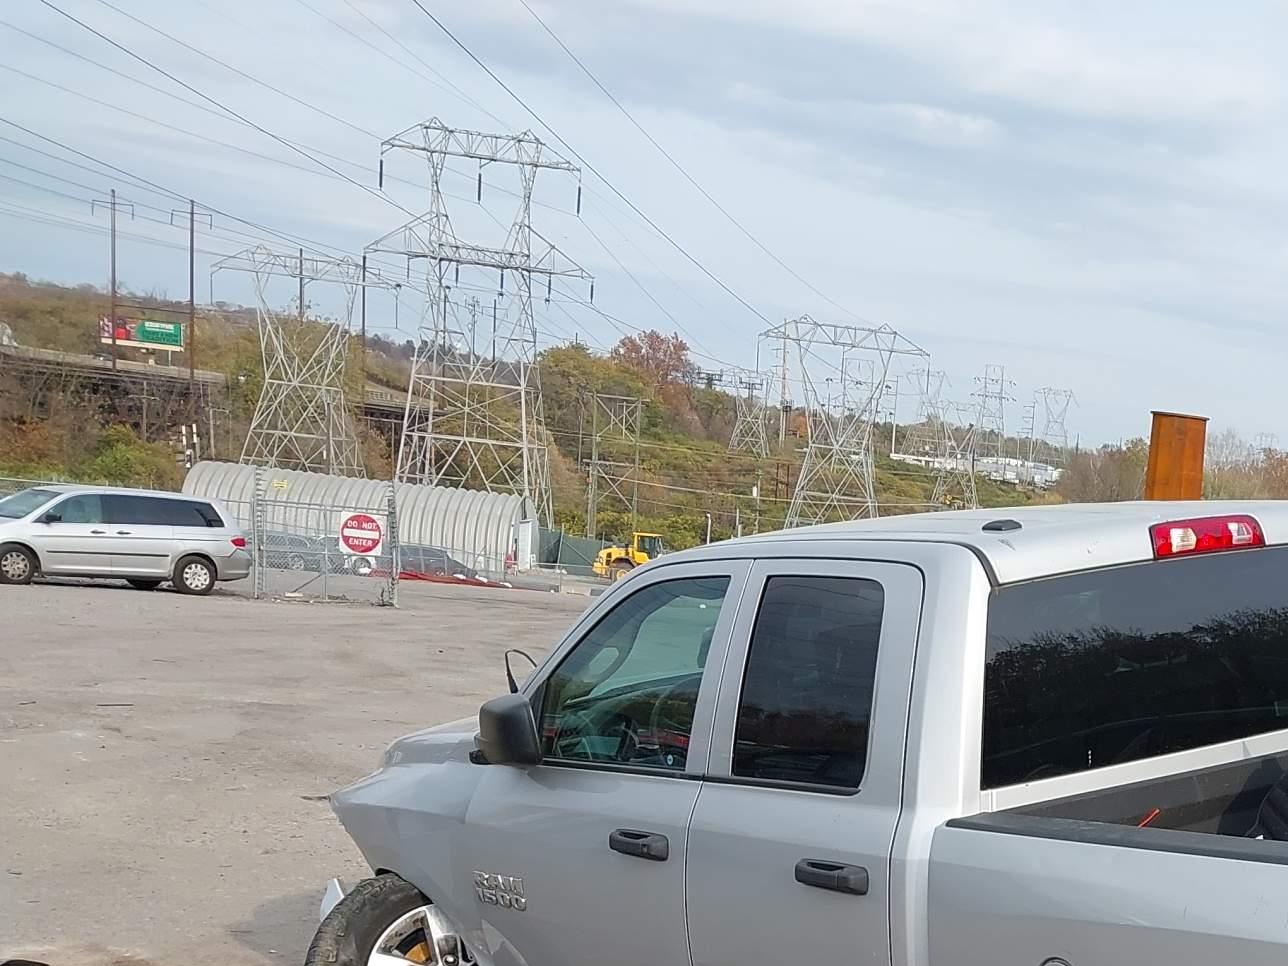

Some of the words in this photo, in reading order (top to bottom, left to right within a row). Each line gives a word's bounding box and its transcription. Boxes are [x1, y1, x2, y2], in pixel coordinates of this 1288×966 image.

[347, 520, 358, 528] DO
[362, 521, 377, 529] NOT
[349, 538, 373, 547] ENTER
[472, 870, 524, 895] RAM
[475, 887, 528, 911] 1500
